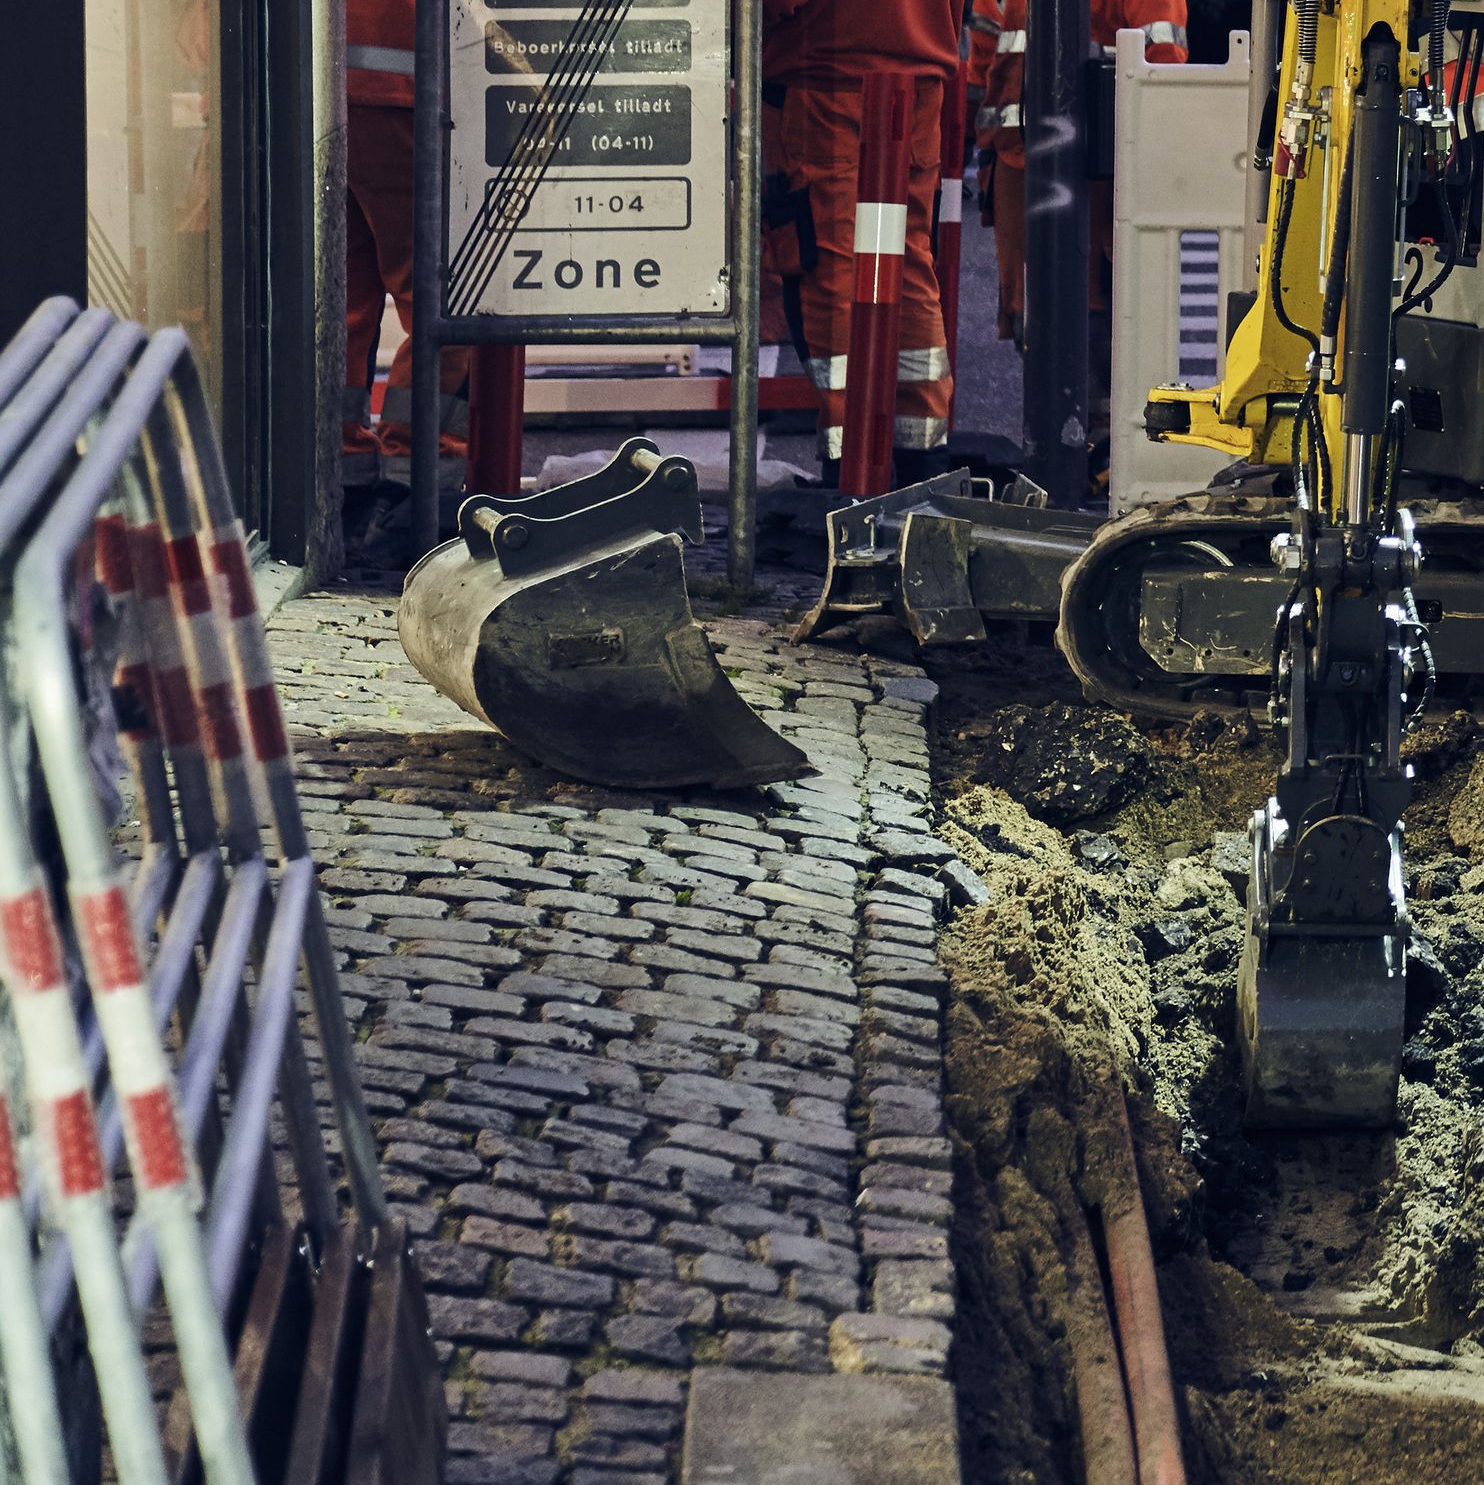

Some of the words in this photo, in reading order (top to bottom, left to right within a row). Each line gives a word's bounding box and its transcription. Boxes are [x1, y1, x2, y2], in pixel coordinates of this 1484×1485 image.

[626, 39, 683, 56] tilladt
[614, 99, 672, 115] tilladt
[591, 134, 654, 152] (04-11)
[574, 195, 645, 213] 11-04
[512, 249, 662, 290] Zone
